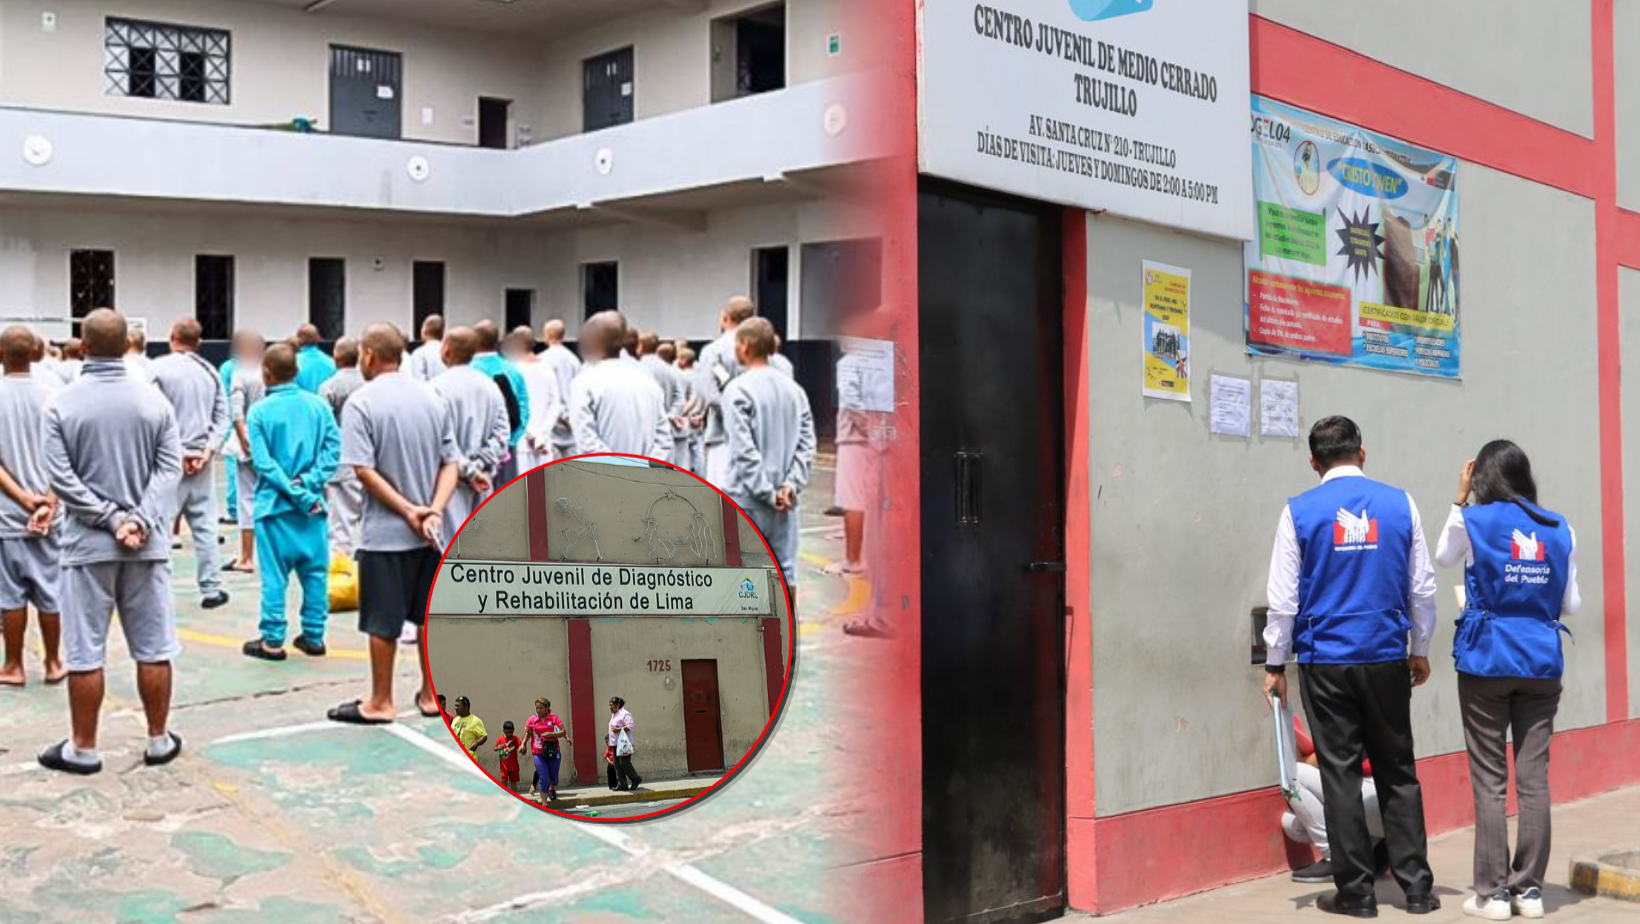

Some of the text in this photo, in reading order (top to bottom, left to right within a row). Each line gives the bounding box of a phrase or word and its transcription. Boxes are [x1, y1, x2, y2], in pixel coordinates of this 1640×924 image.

[974, 4, 1217, 103] CENTRO JUVENIL DE MEDIO CERRADO
[1074, 73, 1137, 117] TRUJILLO
[1029, 115, 1045, 138] AV.
[1046, 118, 1076, 145] SANTA
[1077, 126, 1103, 150] CRUZ
[977, 125, 1219, 205] DÍAS DE VISITA: JUEVES Y DOMINGOS DE 2:00 A 5:00 PM
[451, 564, 713, 591] Centro Juvenil de Diagnóstico
[1505, 564, 1550, 574] Defensoría
[1505, 574, 1549, 583] del Pueblo
[478, 590, 694, 613] y Rehabilitación de Lima
[738, 591, 758, 599] CJDRL
[646, 660, 671, 673] 1725
